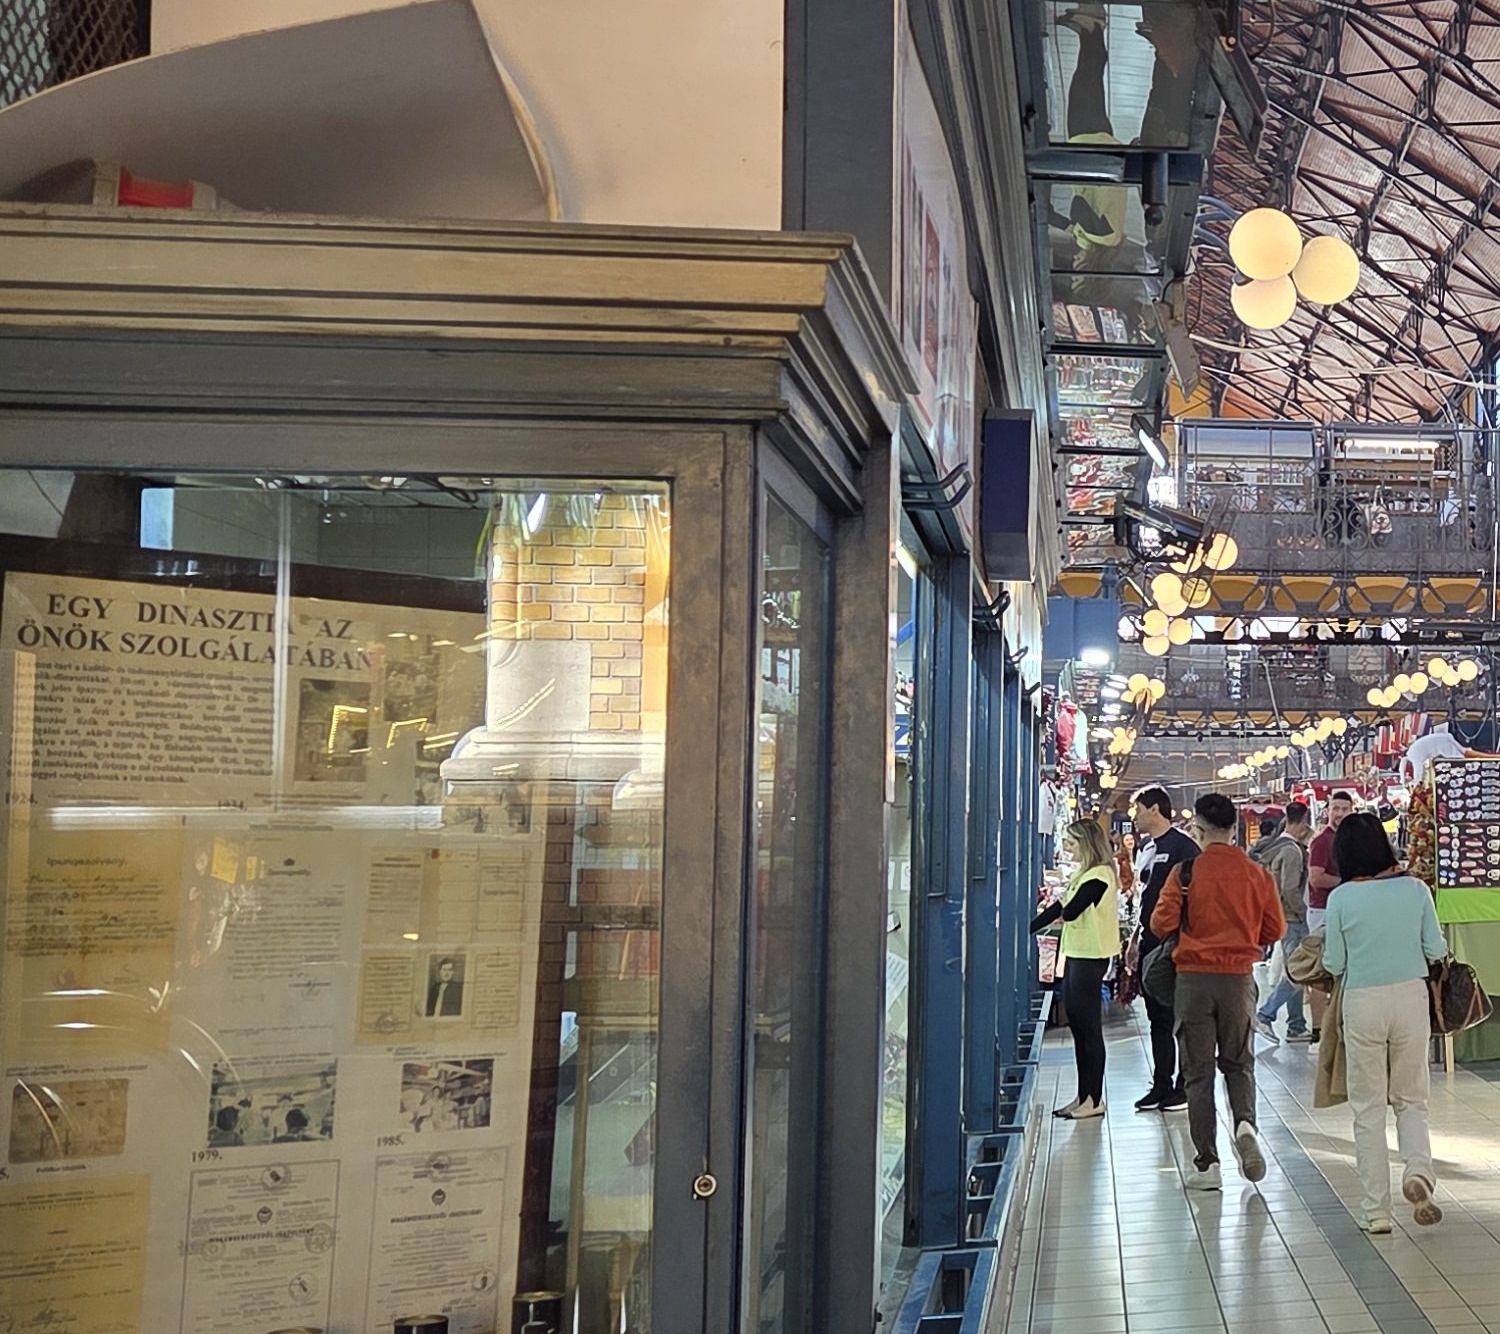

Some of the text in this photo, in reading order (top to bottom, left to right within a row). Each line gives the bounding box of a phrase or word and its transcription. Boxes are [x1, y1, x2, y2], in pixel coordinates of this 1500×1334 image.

[47, 593, 117, 619] EGY
[314, 619, 355, 639] AZ
[17, 618, 374, 671] ÖNÖK SZOLGÁLATÁBAN
[191, 1149, 223, 1163] 1979.
